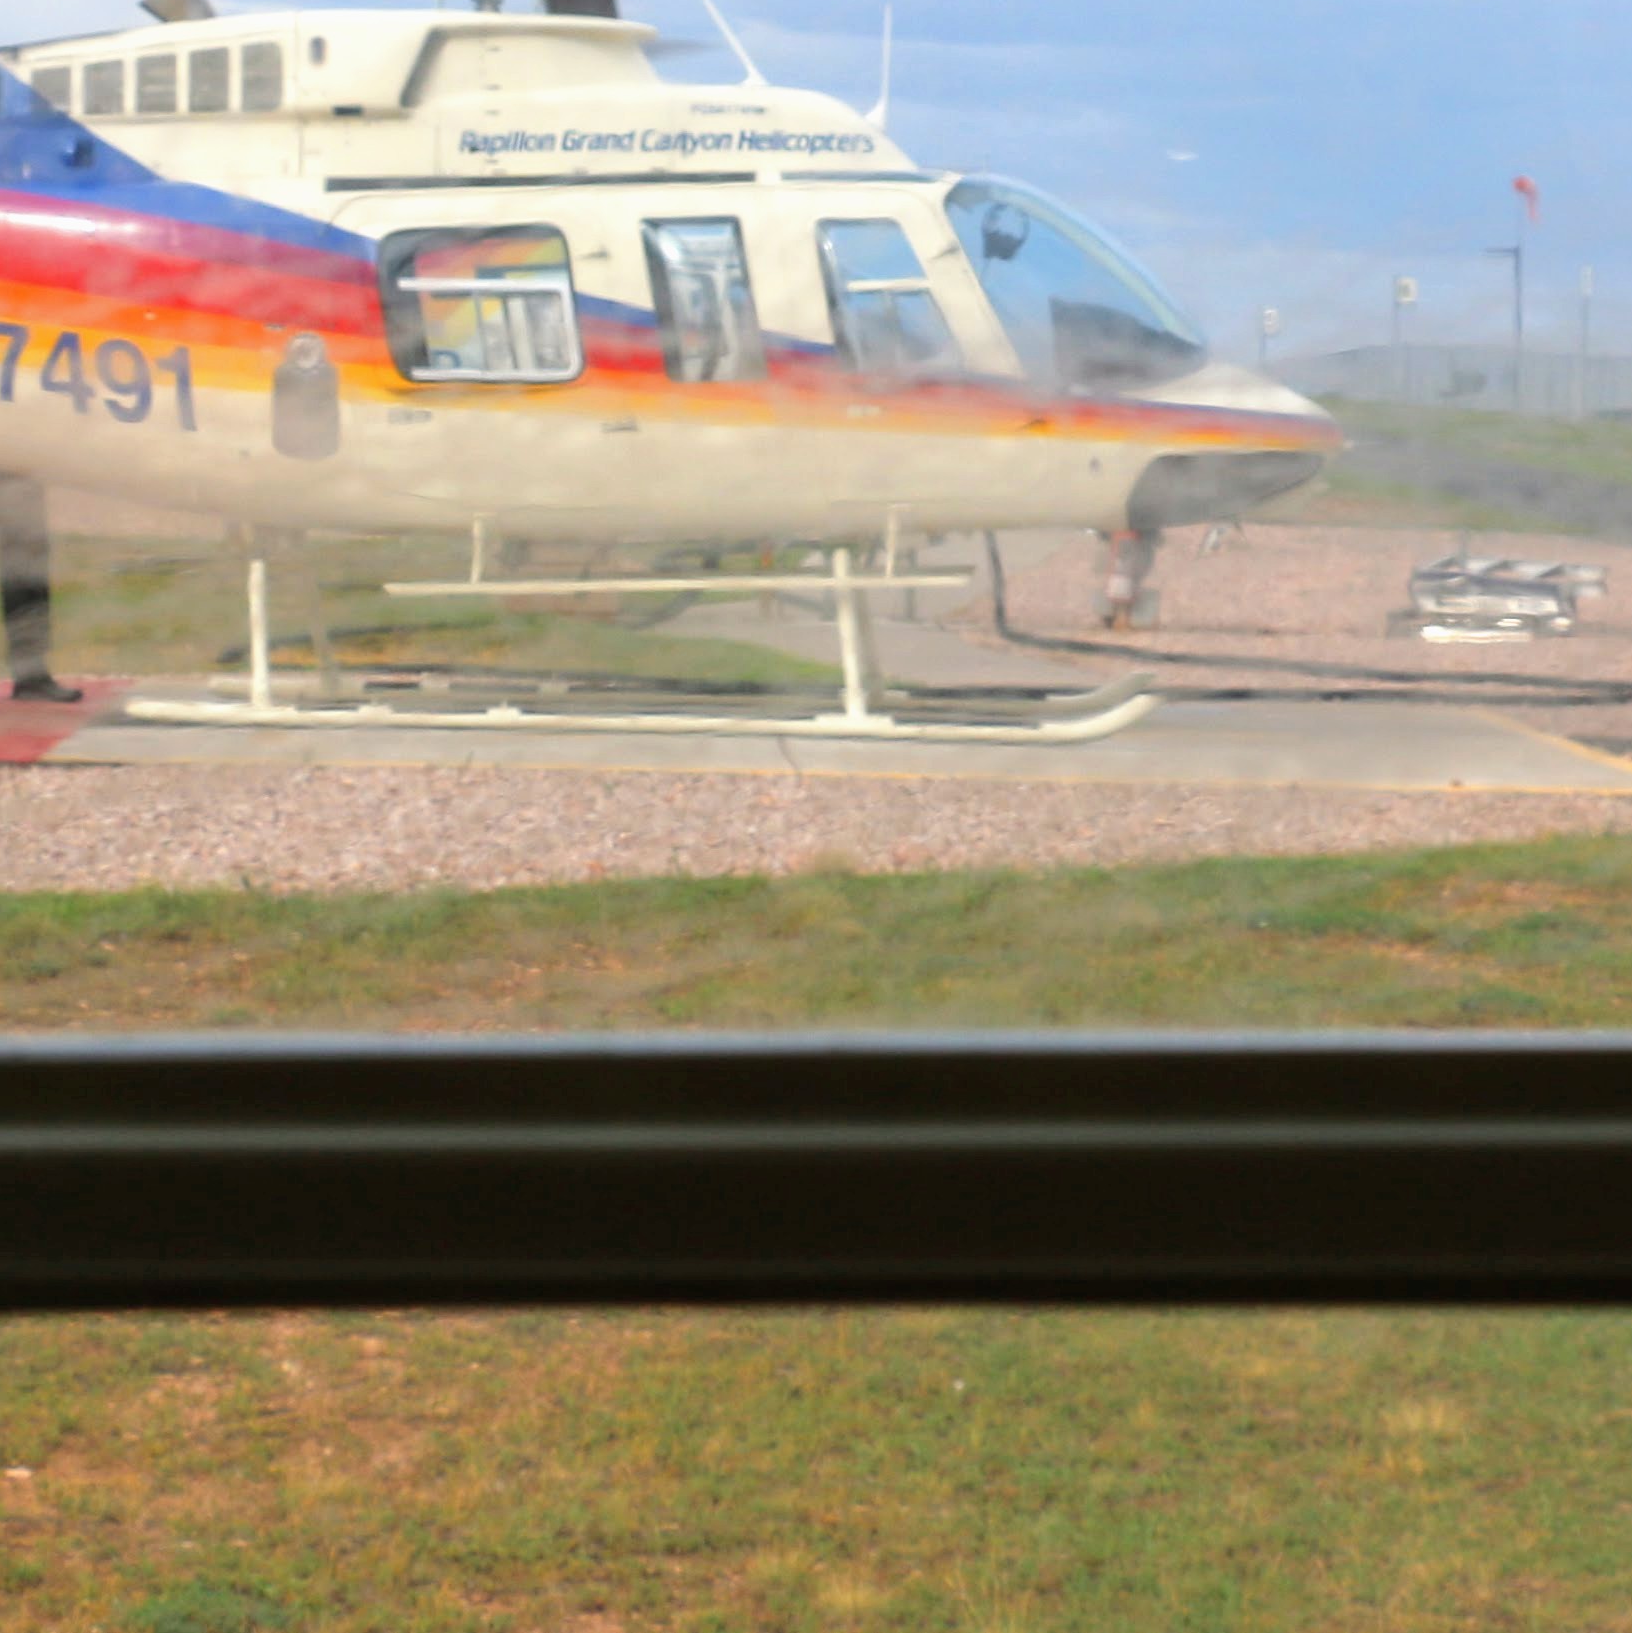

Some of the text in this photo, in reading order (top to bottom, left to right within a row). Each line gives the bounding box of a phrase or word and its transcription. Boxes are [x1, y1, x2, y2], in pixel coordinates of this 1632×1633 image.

[562, 129, 635, 153] Grand
[640, 129, 733, 157] Canyon
[738, 129, 875, 157] Helicopters
